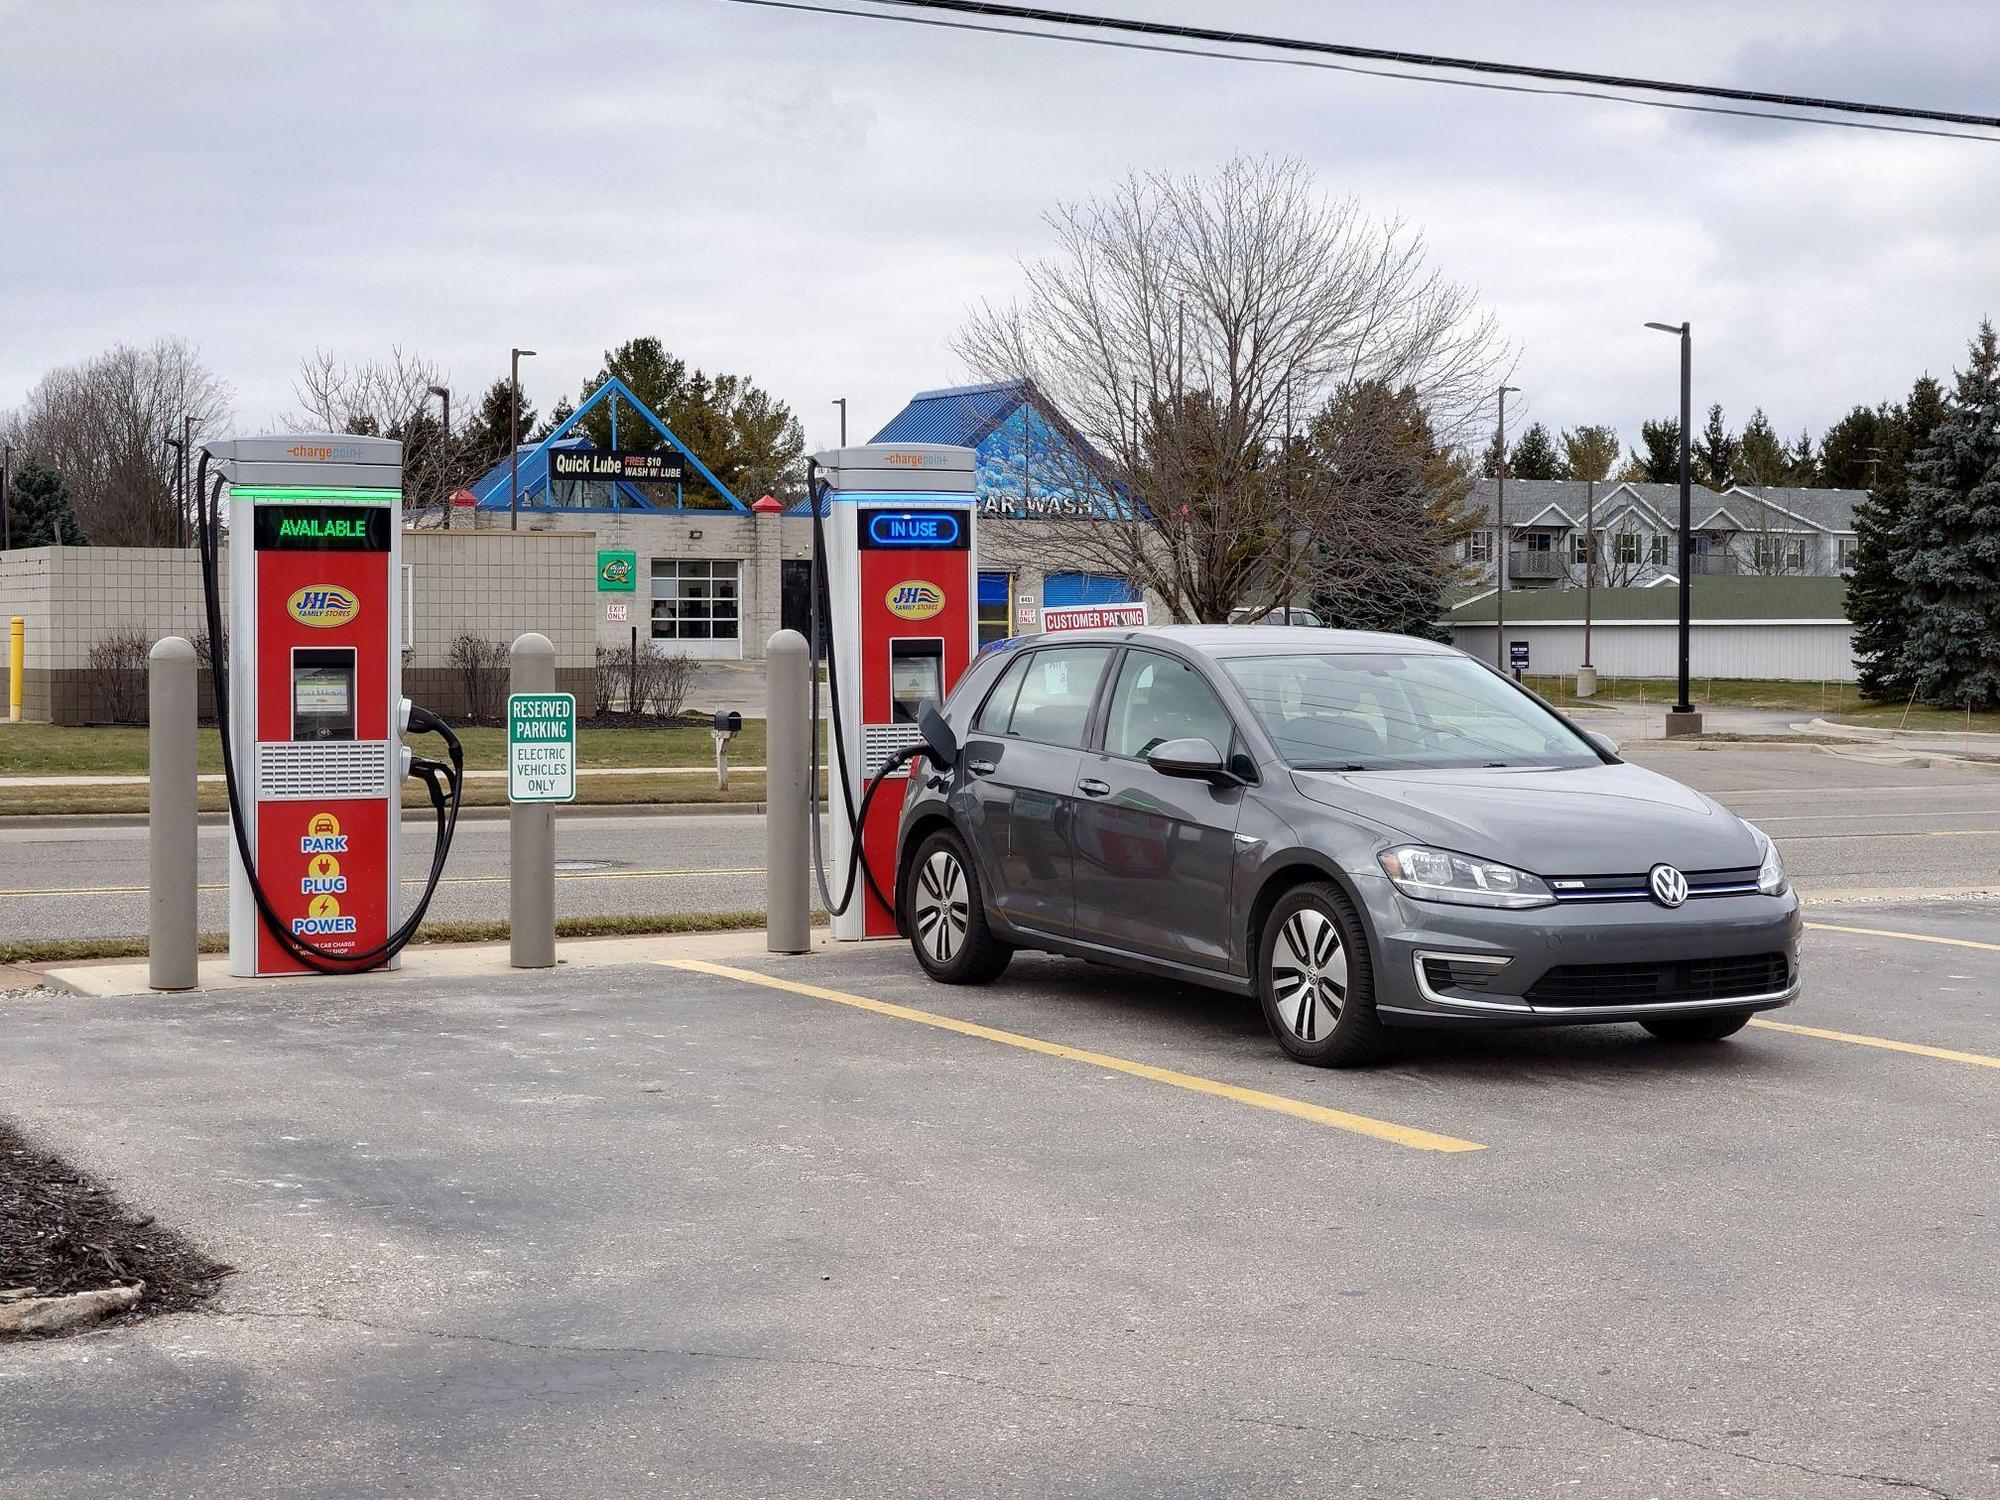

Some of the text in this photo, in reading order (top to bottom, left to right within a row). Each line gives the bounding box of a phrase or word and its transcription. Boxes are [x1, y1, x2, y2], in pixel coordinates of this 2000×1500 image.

[556, 454, 622, 474] Quick Lube
[624, 456, 662, 467] FREE $10
[625, 467, 648, 477] WASH
[660, 468, 681, 478] LUBE
[976, 496, 1093, 514] AR WASH
[280, 519, 366, 537] AVAILABLE
[891, 521, 938, 537] IN USE
[608, 612, 626, 620] ONLY
[609, 605, 625, 613] EXIT
[1047, 613, 1101, 630] CUSTOMER
[513, 700, 570, 718] RESERVED
[516, 720, 567, 739] PARKING
[518, 748, 566, 761] ELECTRIC
[517, 763, 567, 776] VEHICLES
[528, 779, 556, 792] ONLY
[302, 836, 347, 852] PARK
[302, 877, 346, 893] PLUG
[293, 918, 356, 934] POWER
